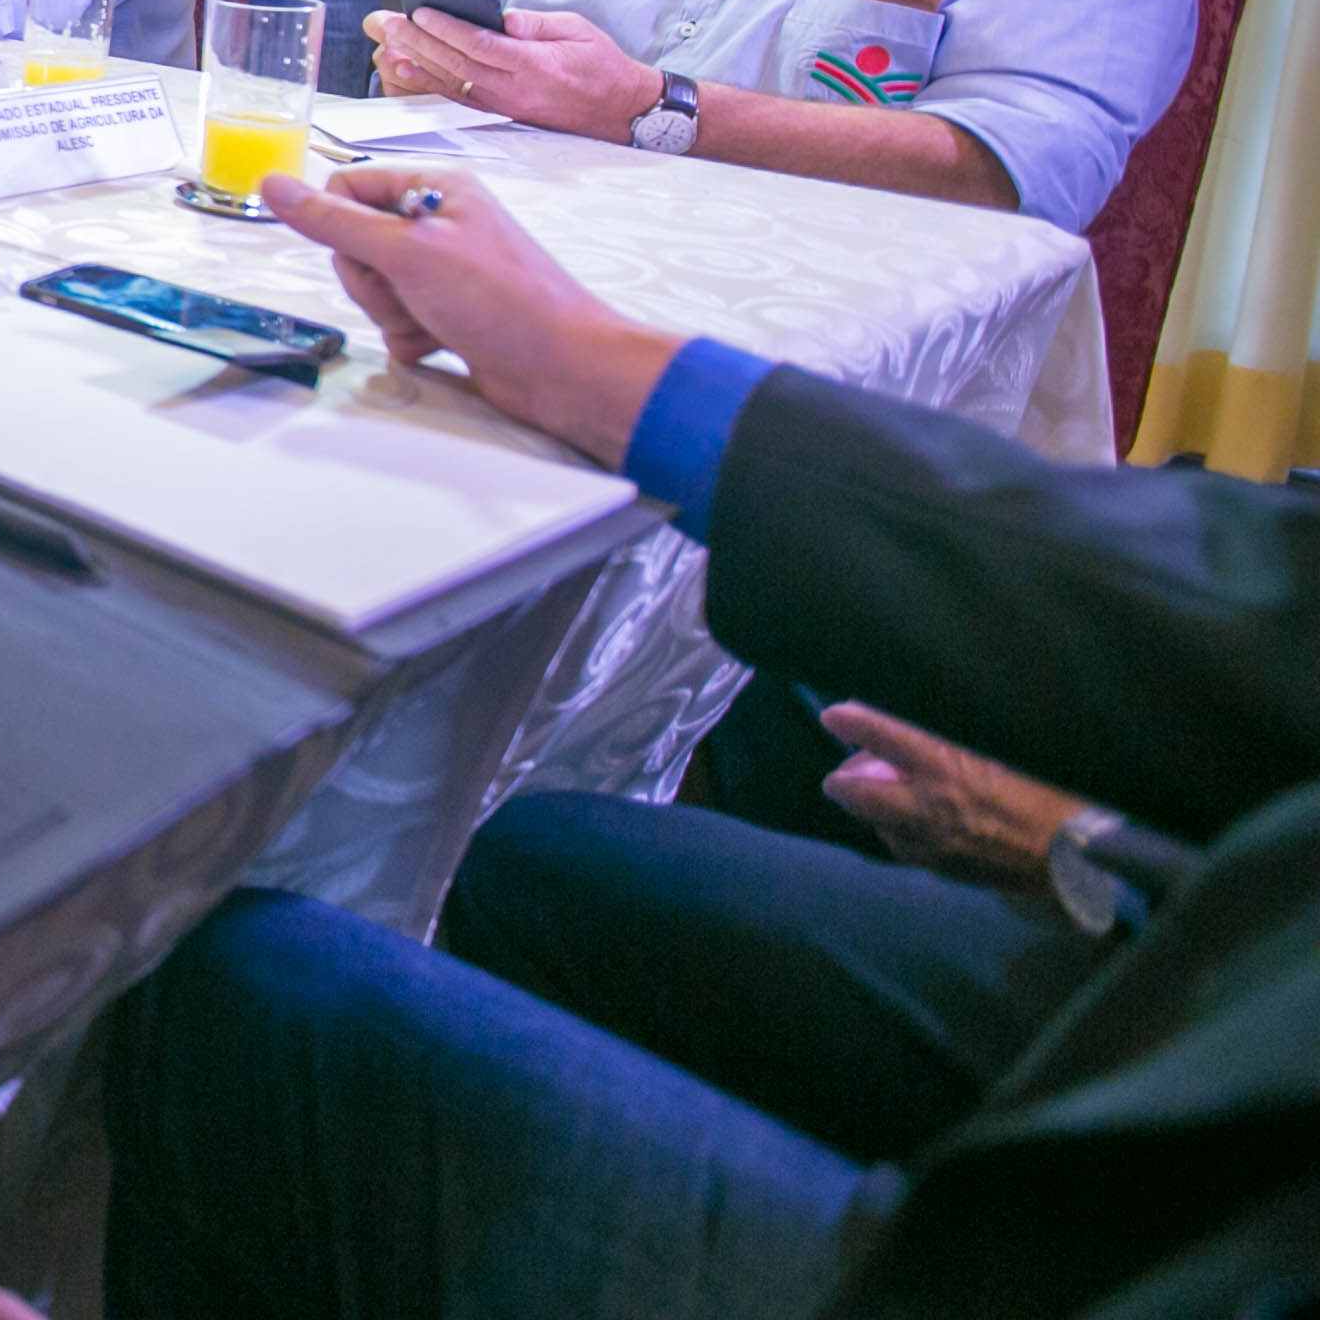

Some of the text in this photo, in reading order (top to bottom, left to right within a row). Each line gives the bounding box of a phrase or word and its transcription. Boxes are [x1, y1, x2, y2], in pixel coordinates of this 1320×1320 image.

[91, 87, 161, 106] PRESIDENTE
[51, 120, 68, 134] DE
[70, 110, 146, 129] AGRICULTURA
[148, 106, 165, 120] DA
[56, 136, 95, 152] ALESC
